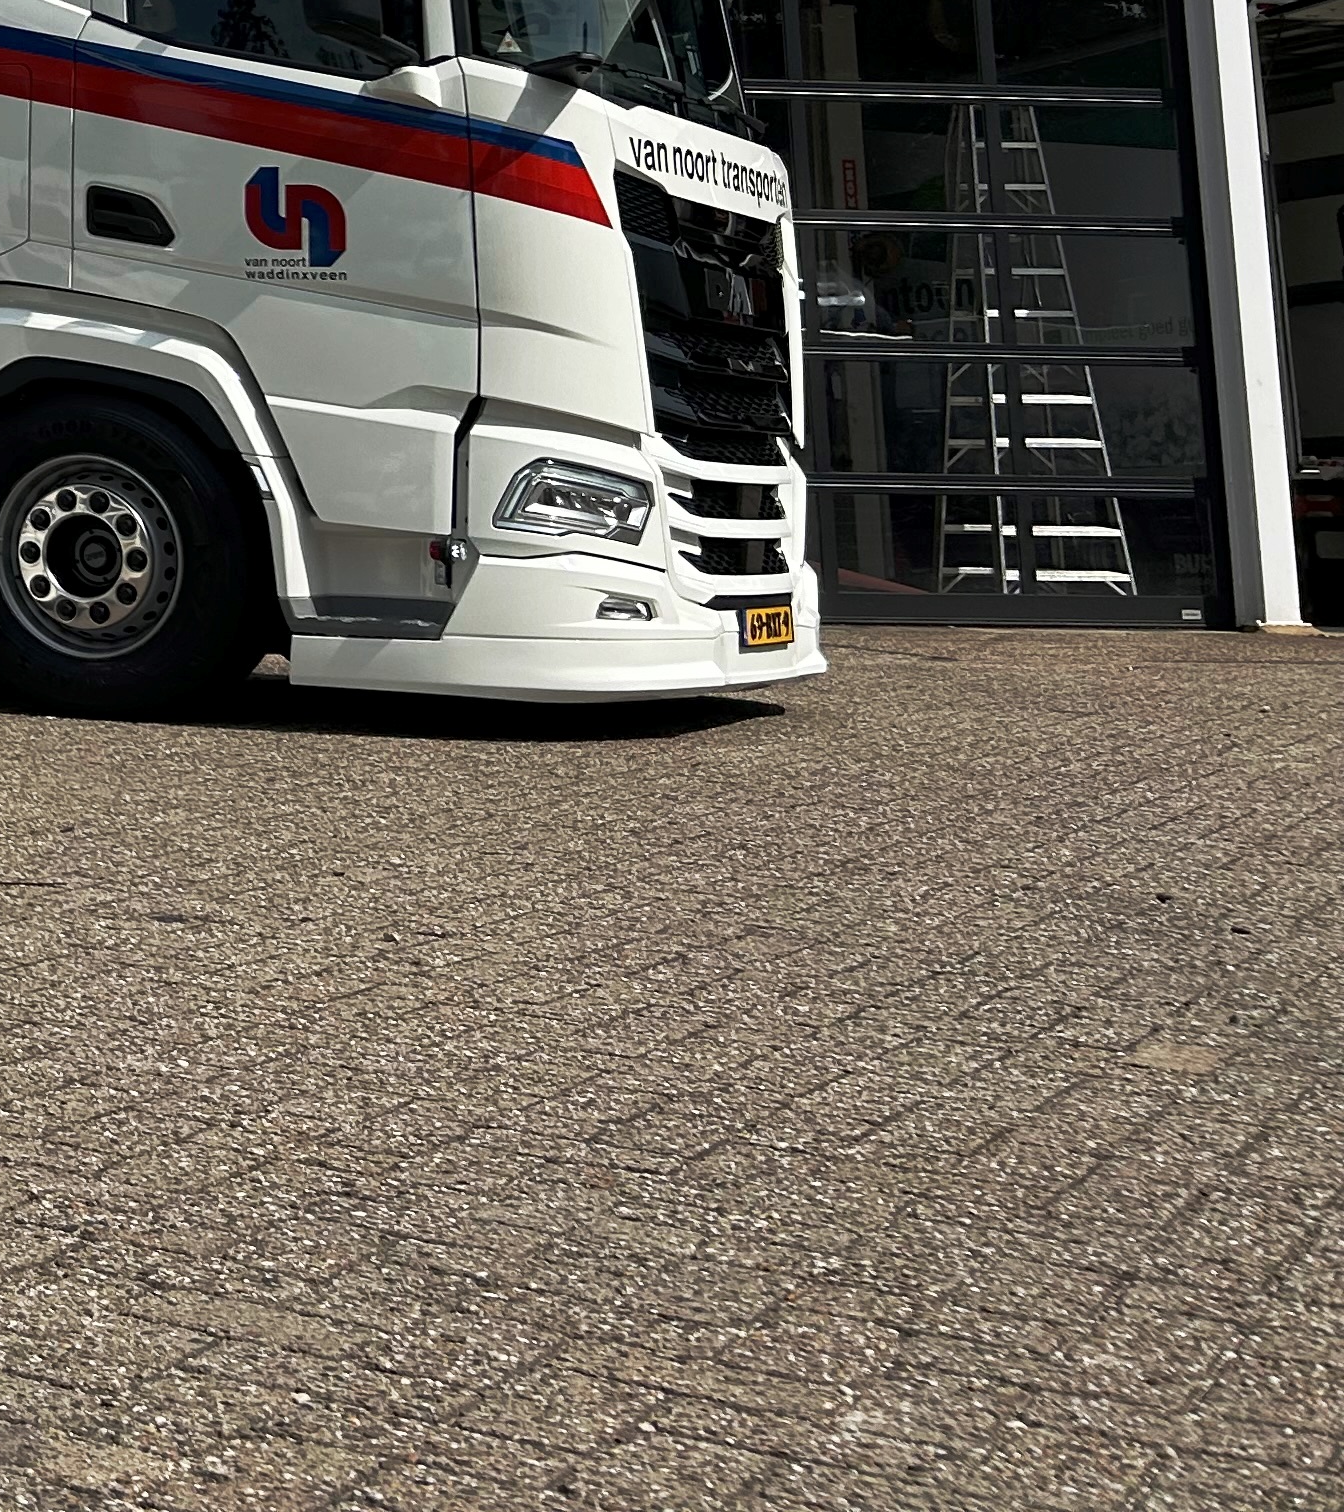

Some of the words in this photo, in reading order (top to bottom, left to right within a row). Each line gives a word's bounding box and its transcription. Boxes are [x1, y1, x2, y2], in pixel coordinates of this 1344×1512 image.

[628, 137, 669, 174] van
[672, 145, 718, 186] noort
[720, 152, 789, 208] transporten
[244, 257, 268, 267] van
[271, 256, 307, 268] noort
[245, 269, 348, 281] waddinxveen
